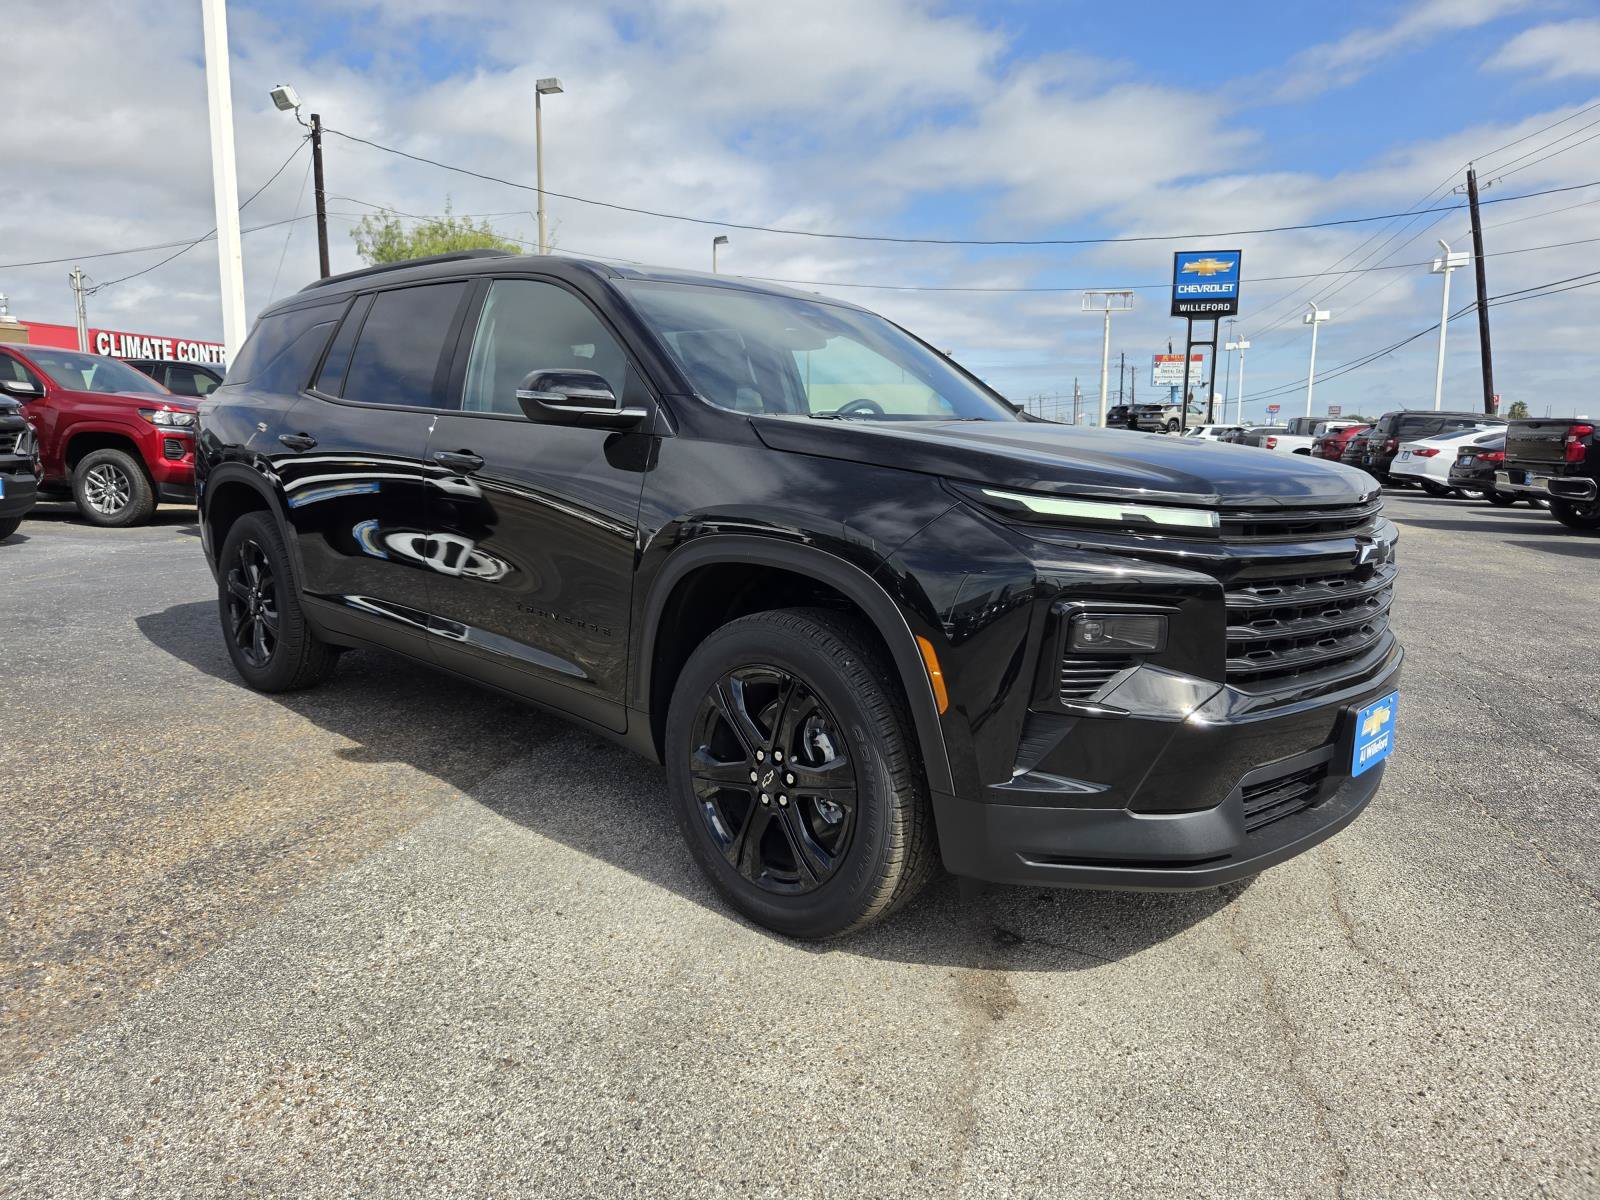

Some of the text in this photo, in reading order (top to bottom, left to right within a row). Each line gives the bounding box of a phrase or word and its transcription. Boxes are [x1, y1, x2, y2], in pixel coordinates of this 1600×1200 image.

[1178, 283, 1235, 293] CHEVROLET
[1179, 303, 1230, 312] WILLEFORD
[96, 332, 174, 361] CLIMATE
